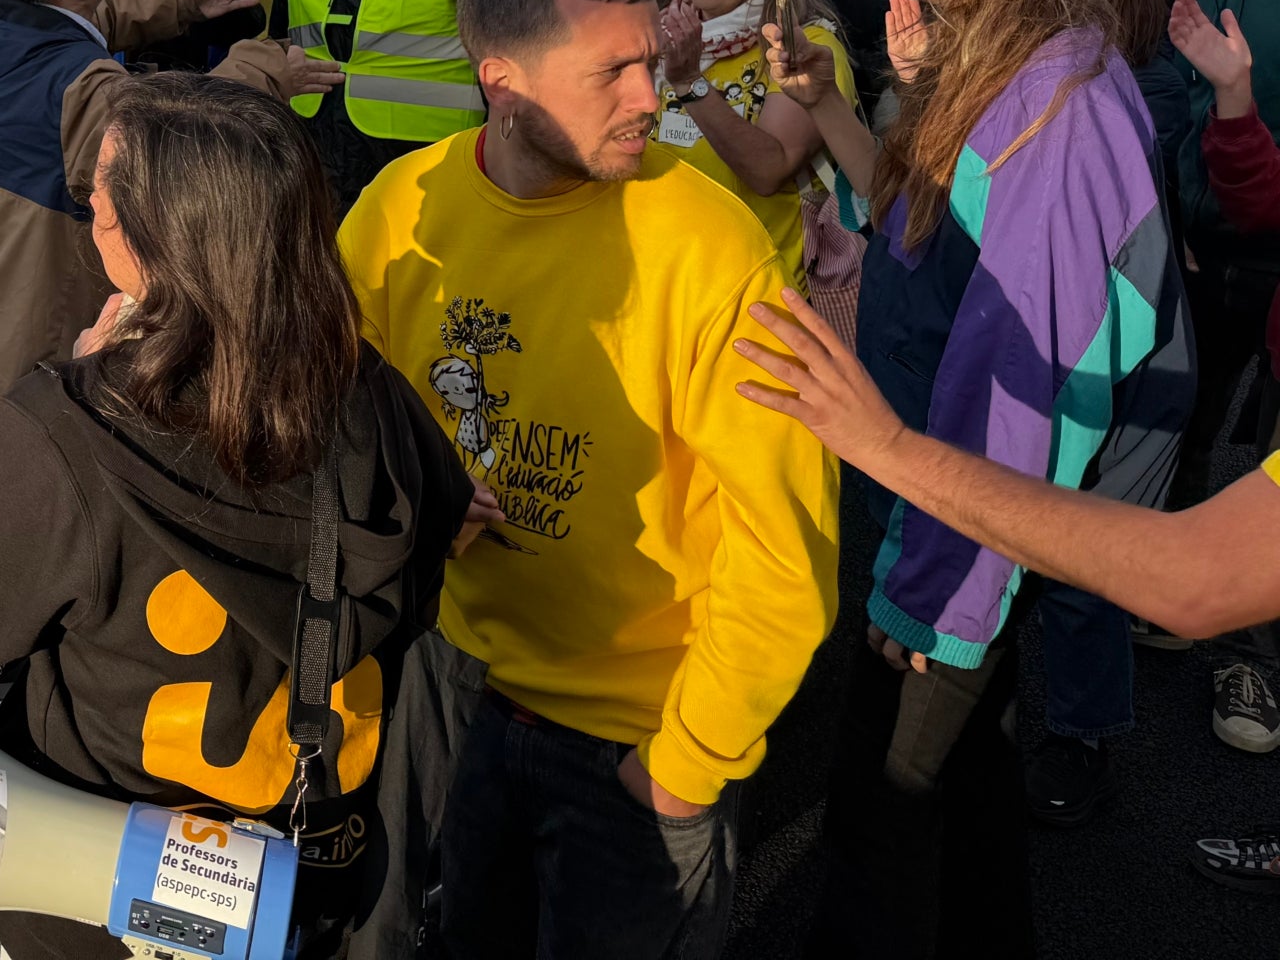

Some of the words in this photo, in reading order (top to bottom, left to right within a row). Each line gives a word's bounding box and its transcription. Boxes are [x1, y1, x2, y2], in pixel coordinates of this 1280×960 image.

[166, 838, 239, 870] Professors
[162, 854, 178, 869] de
[180, 859, 256, 893] Secundària
